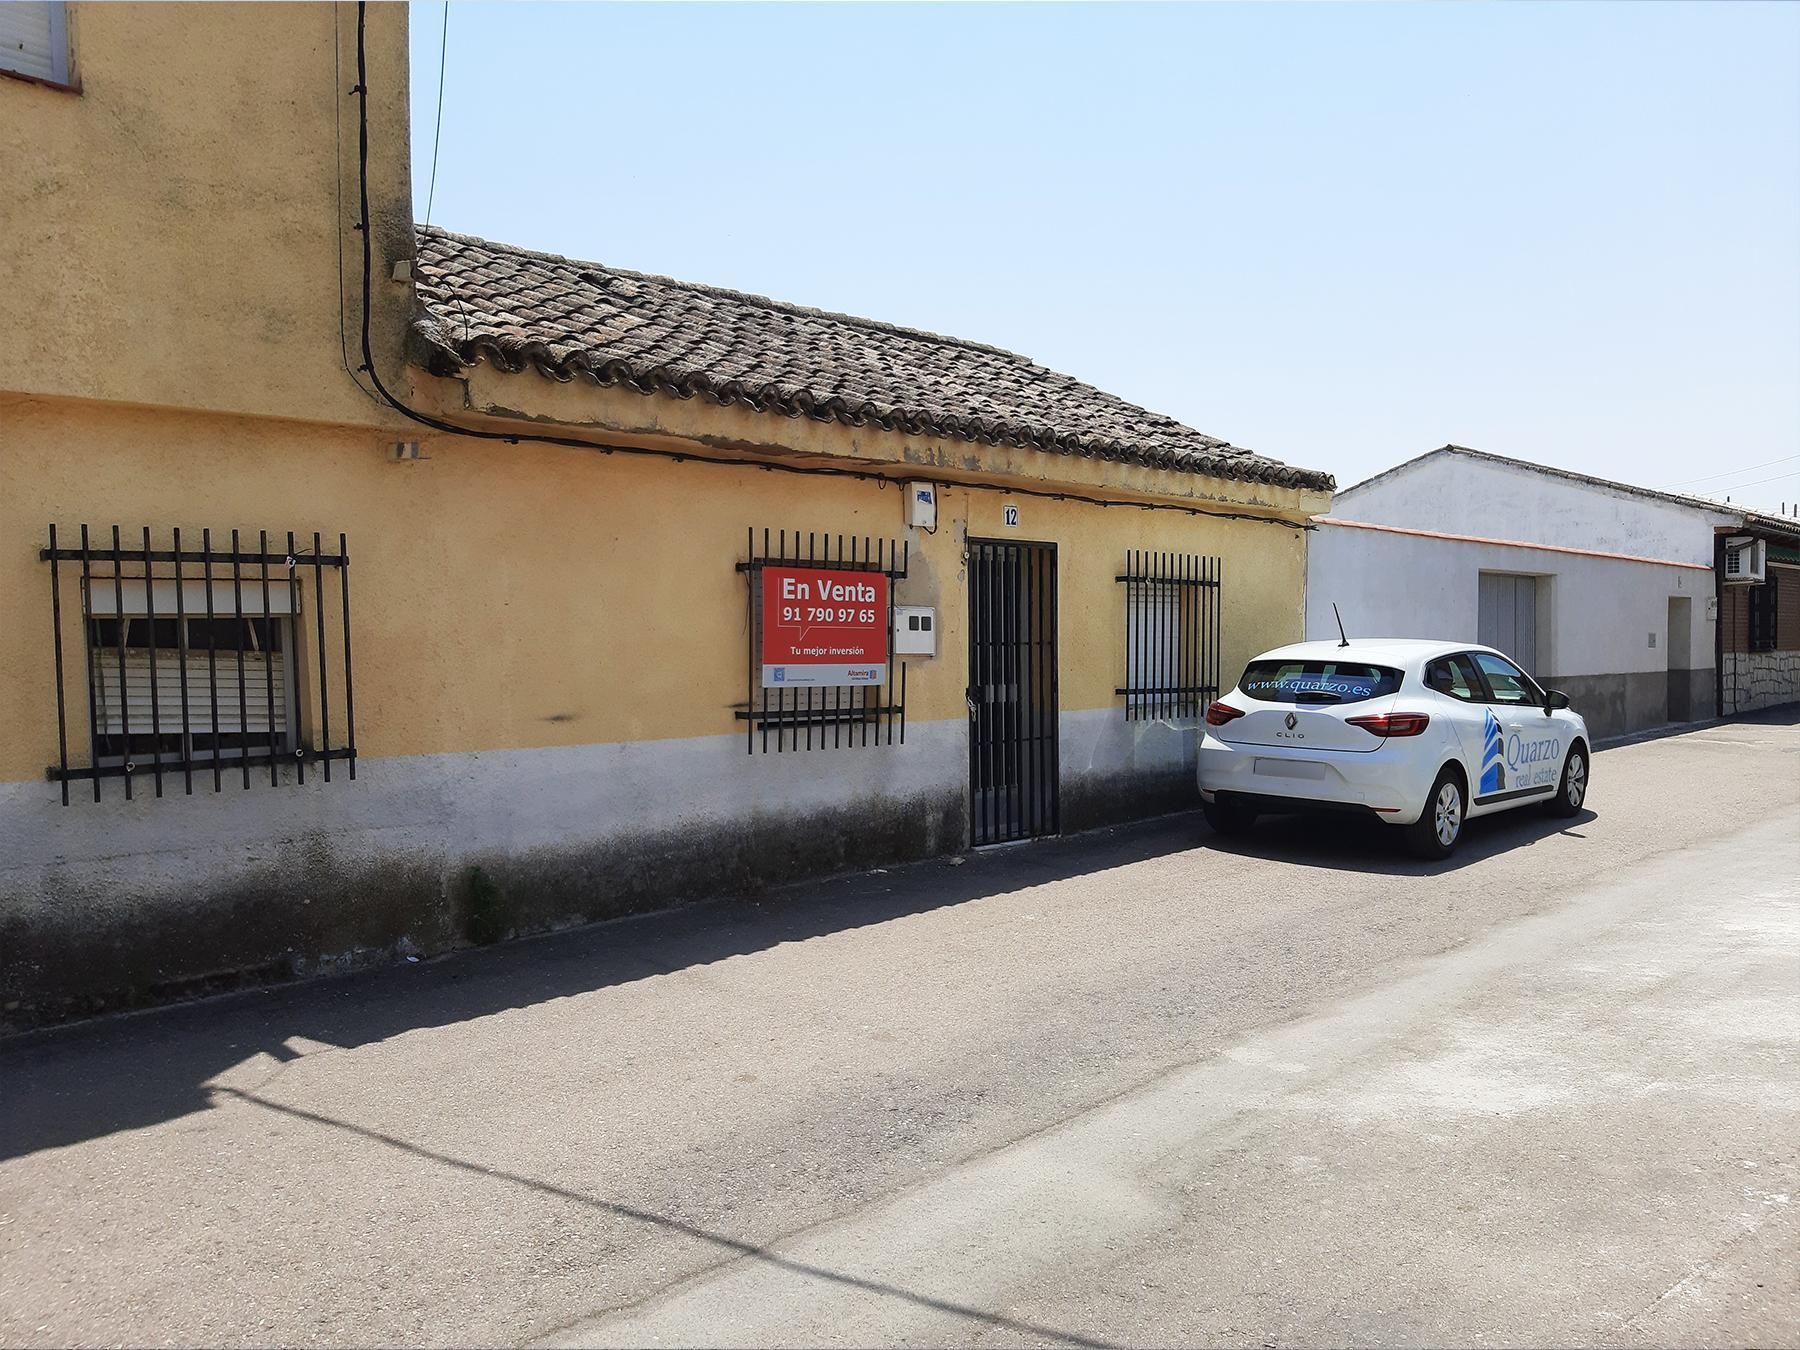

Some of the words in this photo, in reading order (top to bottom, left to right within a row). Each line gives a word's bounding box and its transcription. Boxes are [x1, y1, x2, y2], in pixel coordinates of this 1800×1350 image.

[1005, 508, 1017, 526] 12
[783, 578, 810, 600] En
[817, 579, 875, 602] Venta
[783, 607, 801, 621] 91
[808, 608, 834, 622] 790
[838, 609, 856, 622] 97
[859, 609, 875, 623] 65
[790, 646, 801, 655] Tu
[803, 646, 827, 656] mejor
[829, 646, 864, 655] inversión
[1248, 679, 1371, 696] www.quarzo.es
[1507, 734, 1560, 771] Quarzo
[1515, 764, 1531, 787] real
[1533, 768, 1557, 785] estate
